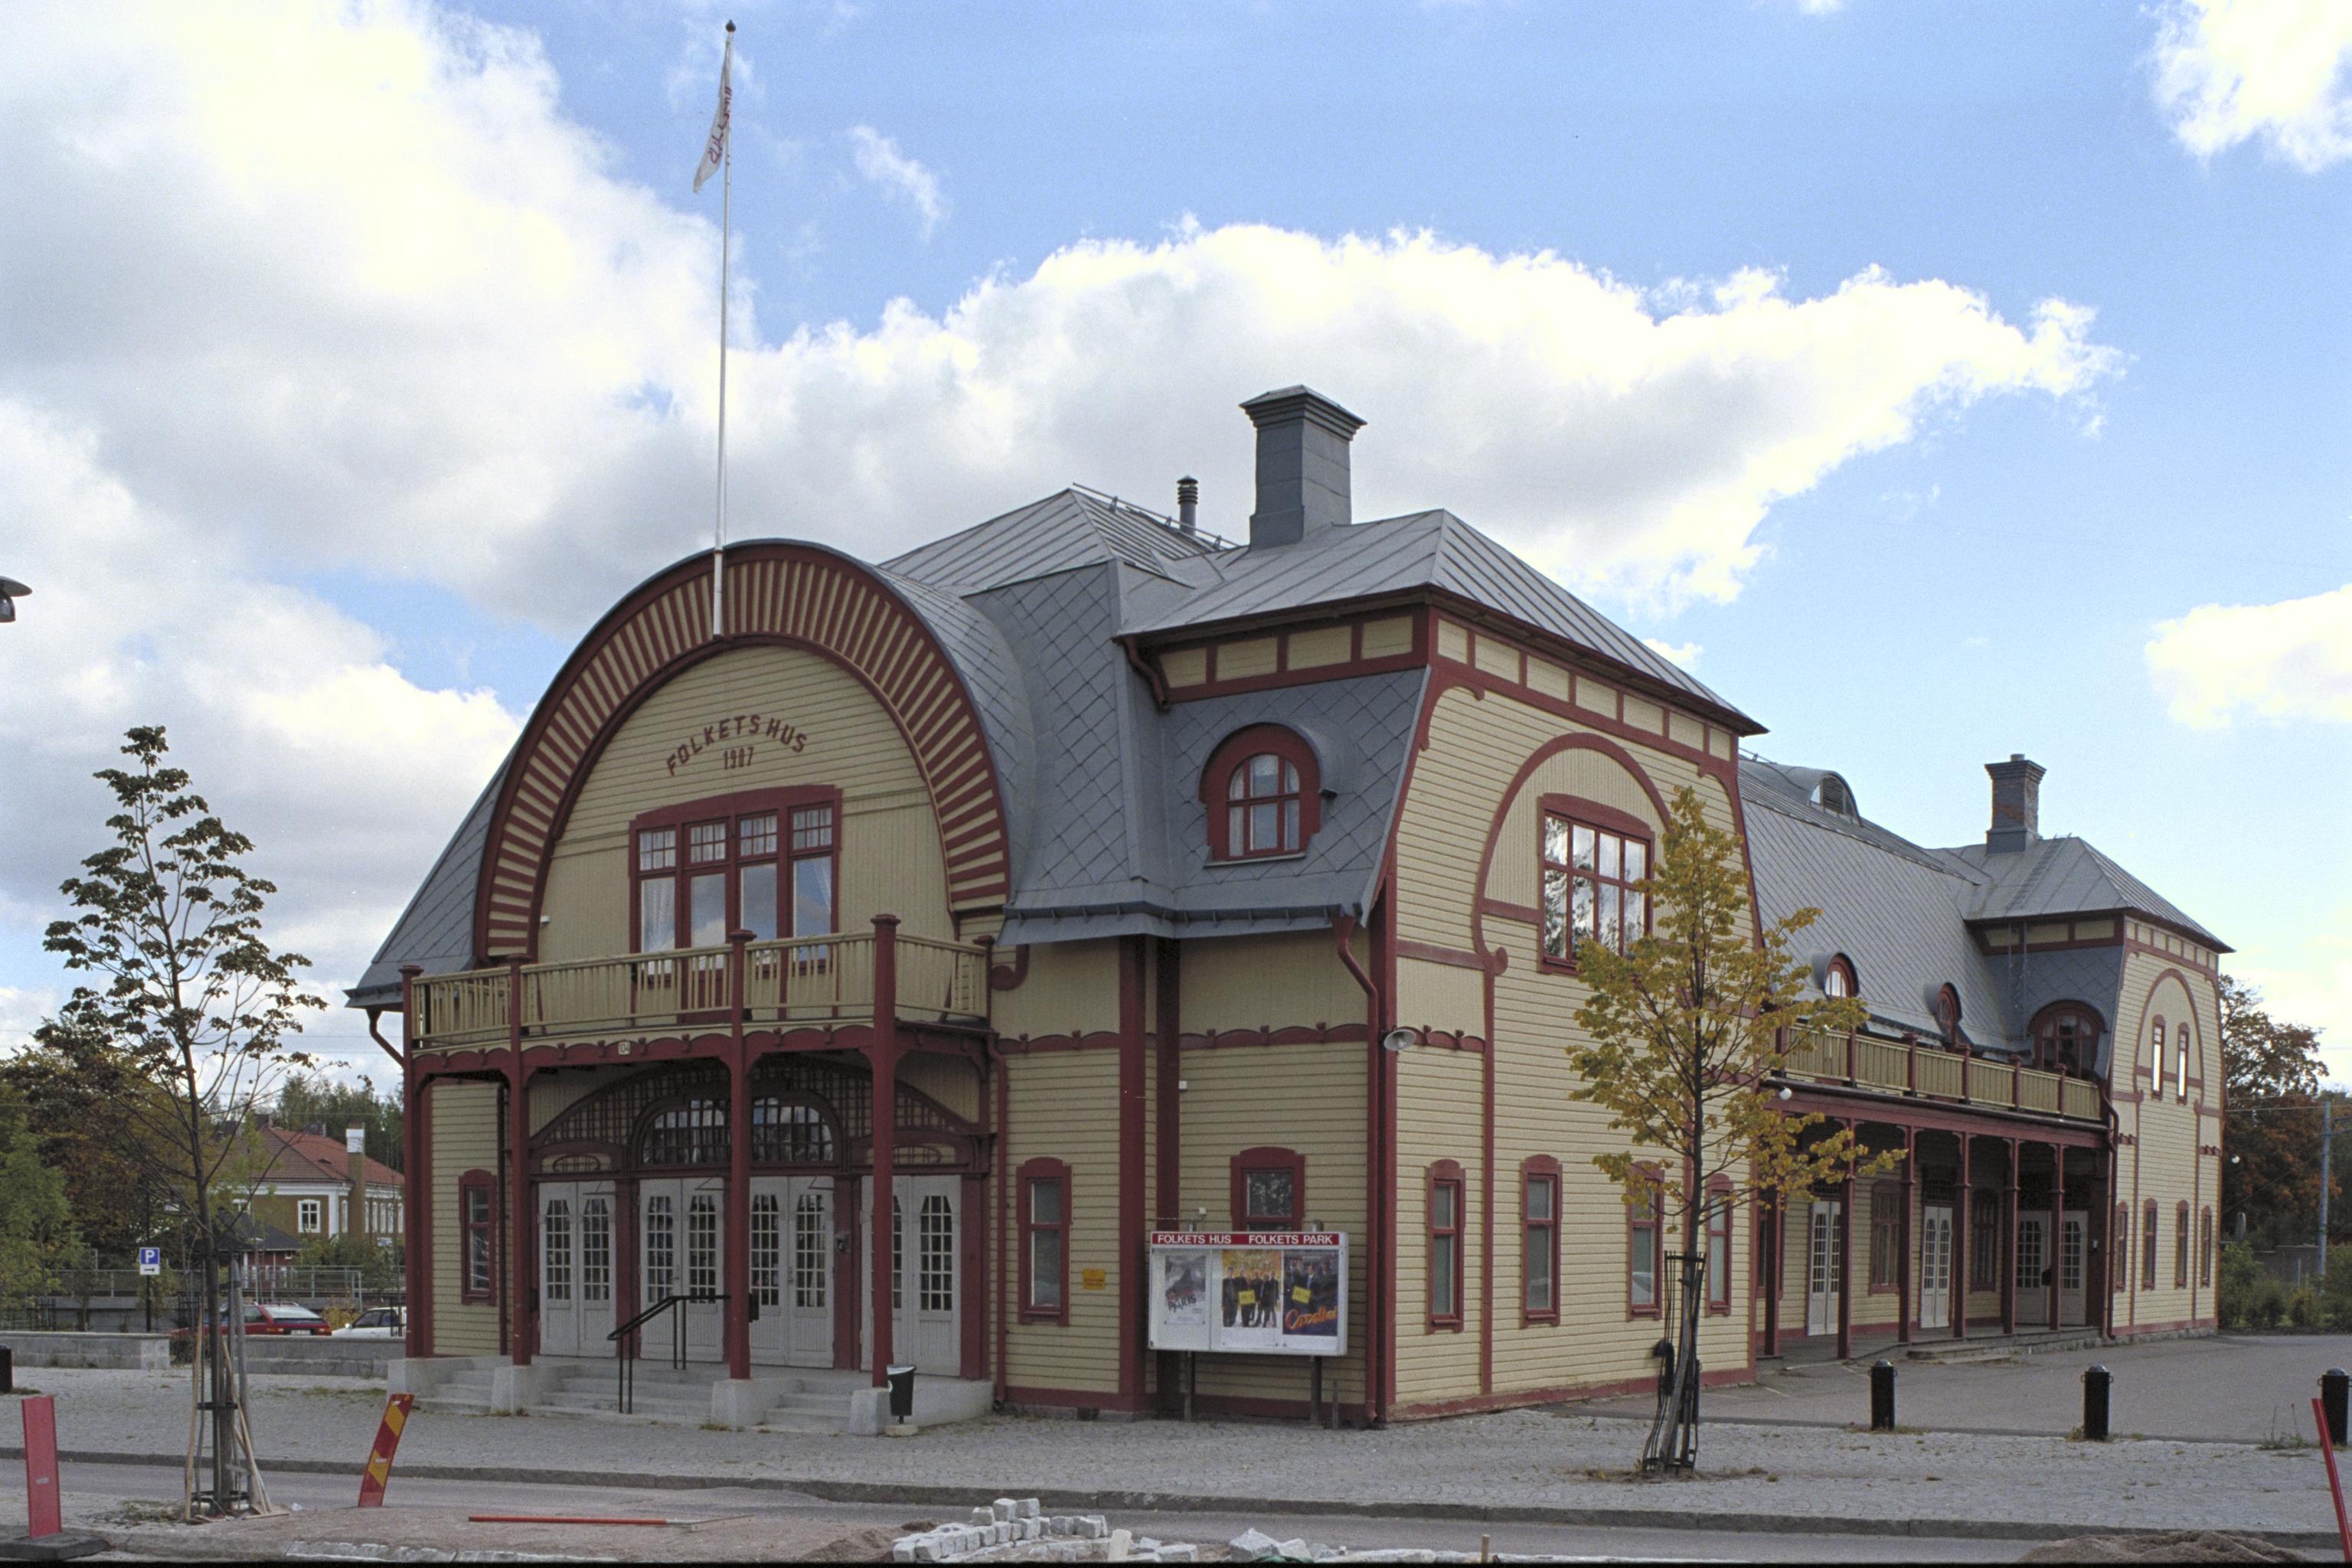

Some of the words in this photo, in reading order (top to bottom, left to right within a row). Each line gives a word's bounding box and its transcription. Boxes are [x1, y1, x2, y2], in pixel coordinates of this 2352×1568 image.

[666, 714, 761, 777] FOLKETS
[766, 717, 808, 753] HUS
[1158, 1234, 1205, 1244] FOLKETS
[1209, 1234, 1232, 1244] HUS
[1249, 1234, 1299, 1244] FOLKETS
[1303, 1234, 1333, 1244] PARK
[145, 1250, 155, 1263] P
